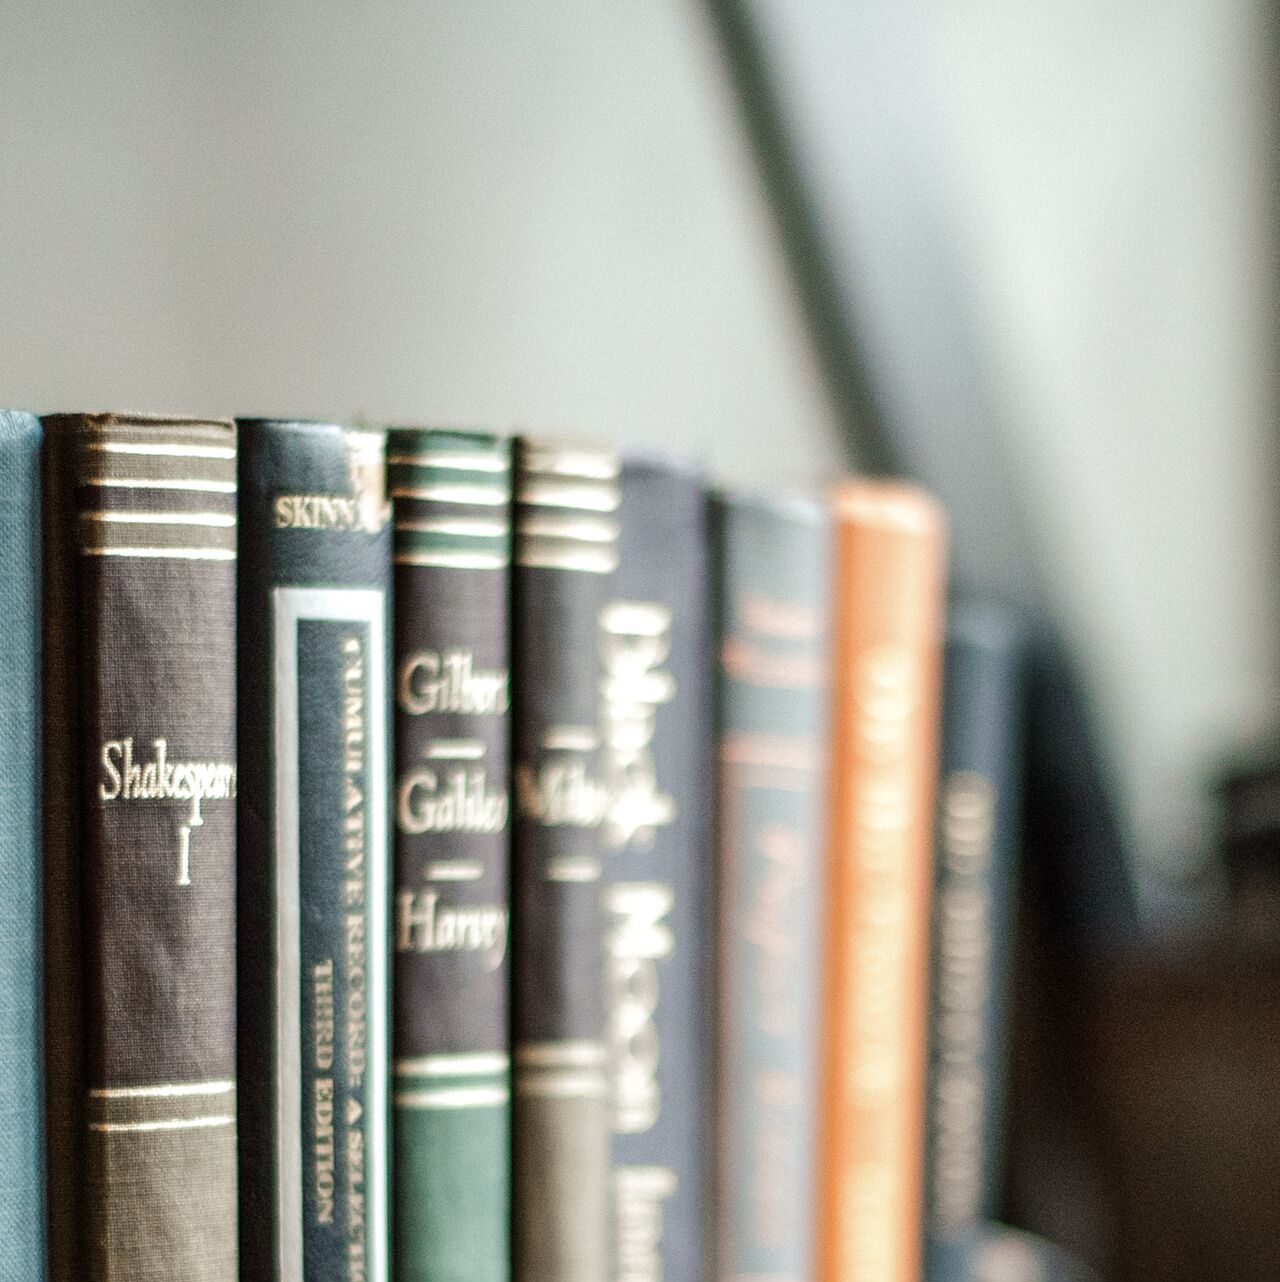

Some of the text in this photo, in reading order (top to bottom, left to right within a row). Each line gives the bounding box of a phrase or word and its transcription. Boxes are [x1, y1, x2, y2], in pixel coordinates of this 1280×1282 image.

[342, 636, 366, 905] CUMULATIVE
[313, 958, 334, 1225] THIRD EDITION
